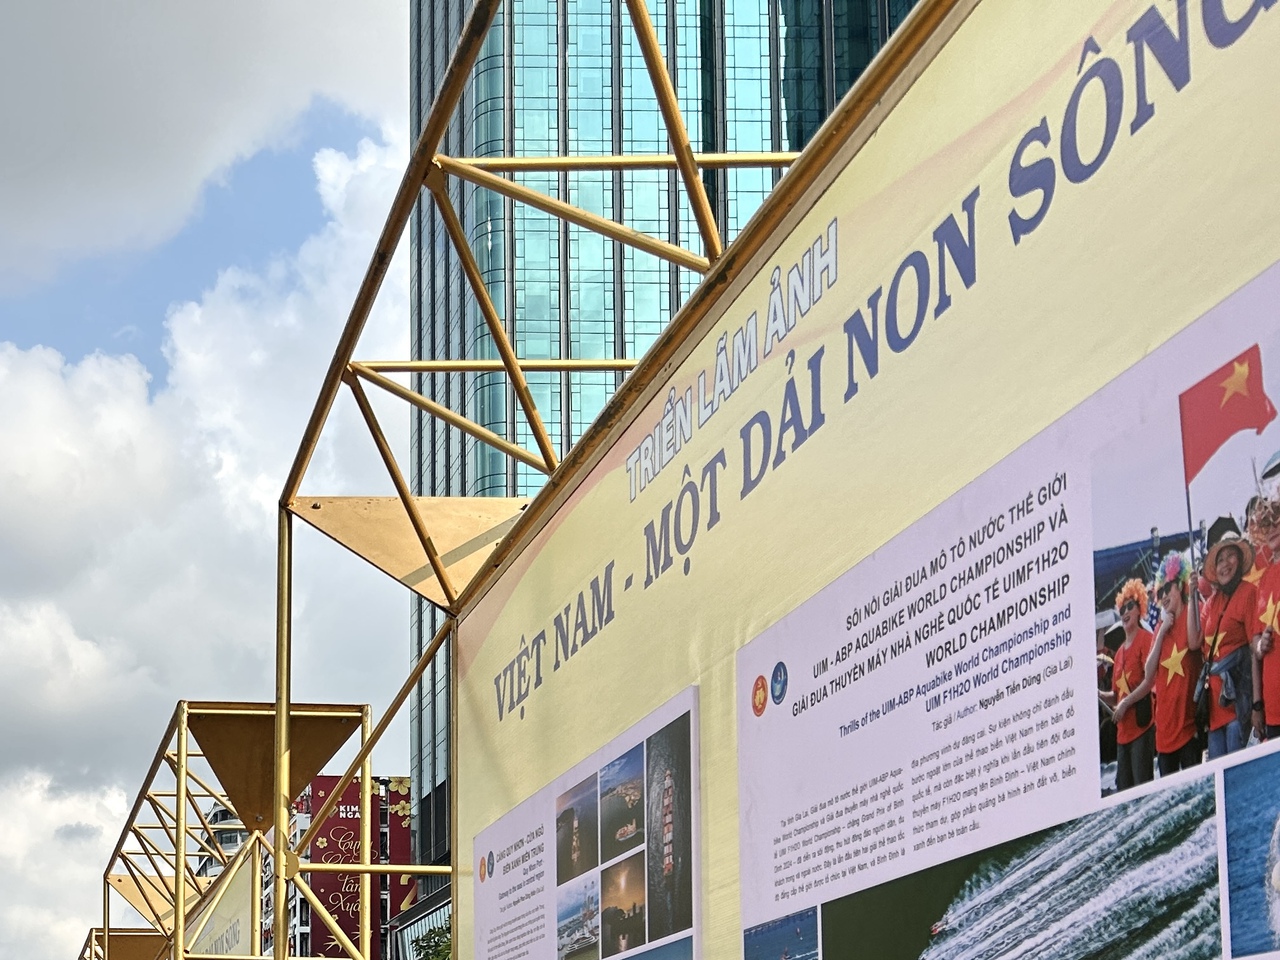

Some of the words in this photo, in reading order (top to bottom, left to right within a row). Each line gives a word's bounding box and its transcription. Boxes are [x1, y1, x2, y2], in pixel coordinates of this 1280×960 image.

[626, 386, 692, 503] TRIỂN
[697, 310, 758, 429] LÃM
[764, 216, 838, 359] ẢNH
[494, 628, 546, 722] VIỆT
[553, 559, 615, 672] NAM
[624, 573, 634, 592] -
[643, 448, 727, 590] MỘT
[740, 344, 826, 500] DẢI
[844, 186, 979, 404] NON
[813, 657, 829, 678] UIM
[834, 642, 853, 666] ABP
[854, 608, 905, 653] AQUABIKE
[906, 583, 947, 620] WORLD
[950, 521, 1045, 593] CHAMPIONSHIP
[1048, 505, 1068, 532] VÀ
[846, 608, 862, 631] SÔI
[882, 581, 902, 606] GIẢI
[904, 566, 928, 593] ĐUA
[930, 549, 948, 577] MÔ
[950, 537, 966, 562] TÔ
[969, 514, 1005, 552] NƯỚC
[1008, 491, 1034, 524] THẾ
[1038, 472, 1067, 505] GIỚI
[792, 695, 809, 717] GIẢI
[810, 685, 828, 707] ĐUA
[829, 662, 865, 695] THUYỀN
[867, 647, 888, 673] MÁY
[890, 631, 912, 660] NHÀ
[914, 611, 945, 645] NGHỀ
[947, 593, 981, 625] QUỐC
[984, 577, 1000, 603] TẾ
[1003, 541, 1069, 593] UIMF1H2O
[839, 719, 860, 738] Thrills
[860, 712, 868, 726] of
[869, 709, 881, 722] the
[882, 688, 914, 715] UIM-ABP
[915, 671, 953, 698] Aquabike
[954, 652, 980, 677] World
[982, 619, 1050, 662] Championship
[1052, 603, 1071, 626] and
[925, 632, 967, 668] WORLD
[970, 574, 1070, 643] CHAMPIONSHIP
[925, 694, 941, 712] UIM
[942, 679, 971, 704] F1H2O
[972, 664, 999, 688] World
[1001, 630, 1072, 674] Championship
[931, 721, 943, 731] Tác
[943, 714, 953, 729] giả
[956, 704, 978, 720] Author:
[978, 689, 1004, 710] Nguyễn
[1006, 681, 1020, 696] Tiến
[1022, 673, 1041, 689] Dũng
[1042, 665, 1058, 681] (Gia
[1018, 727, 1033, 738] Nam
[1062, 728, 1075, 739] đua
[1026, 761, 1038, 773] Việt
[1040, 756, 1055, 767] Nam
